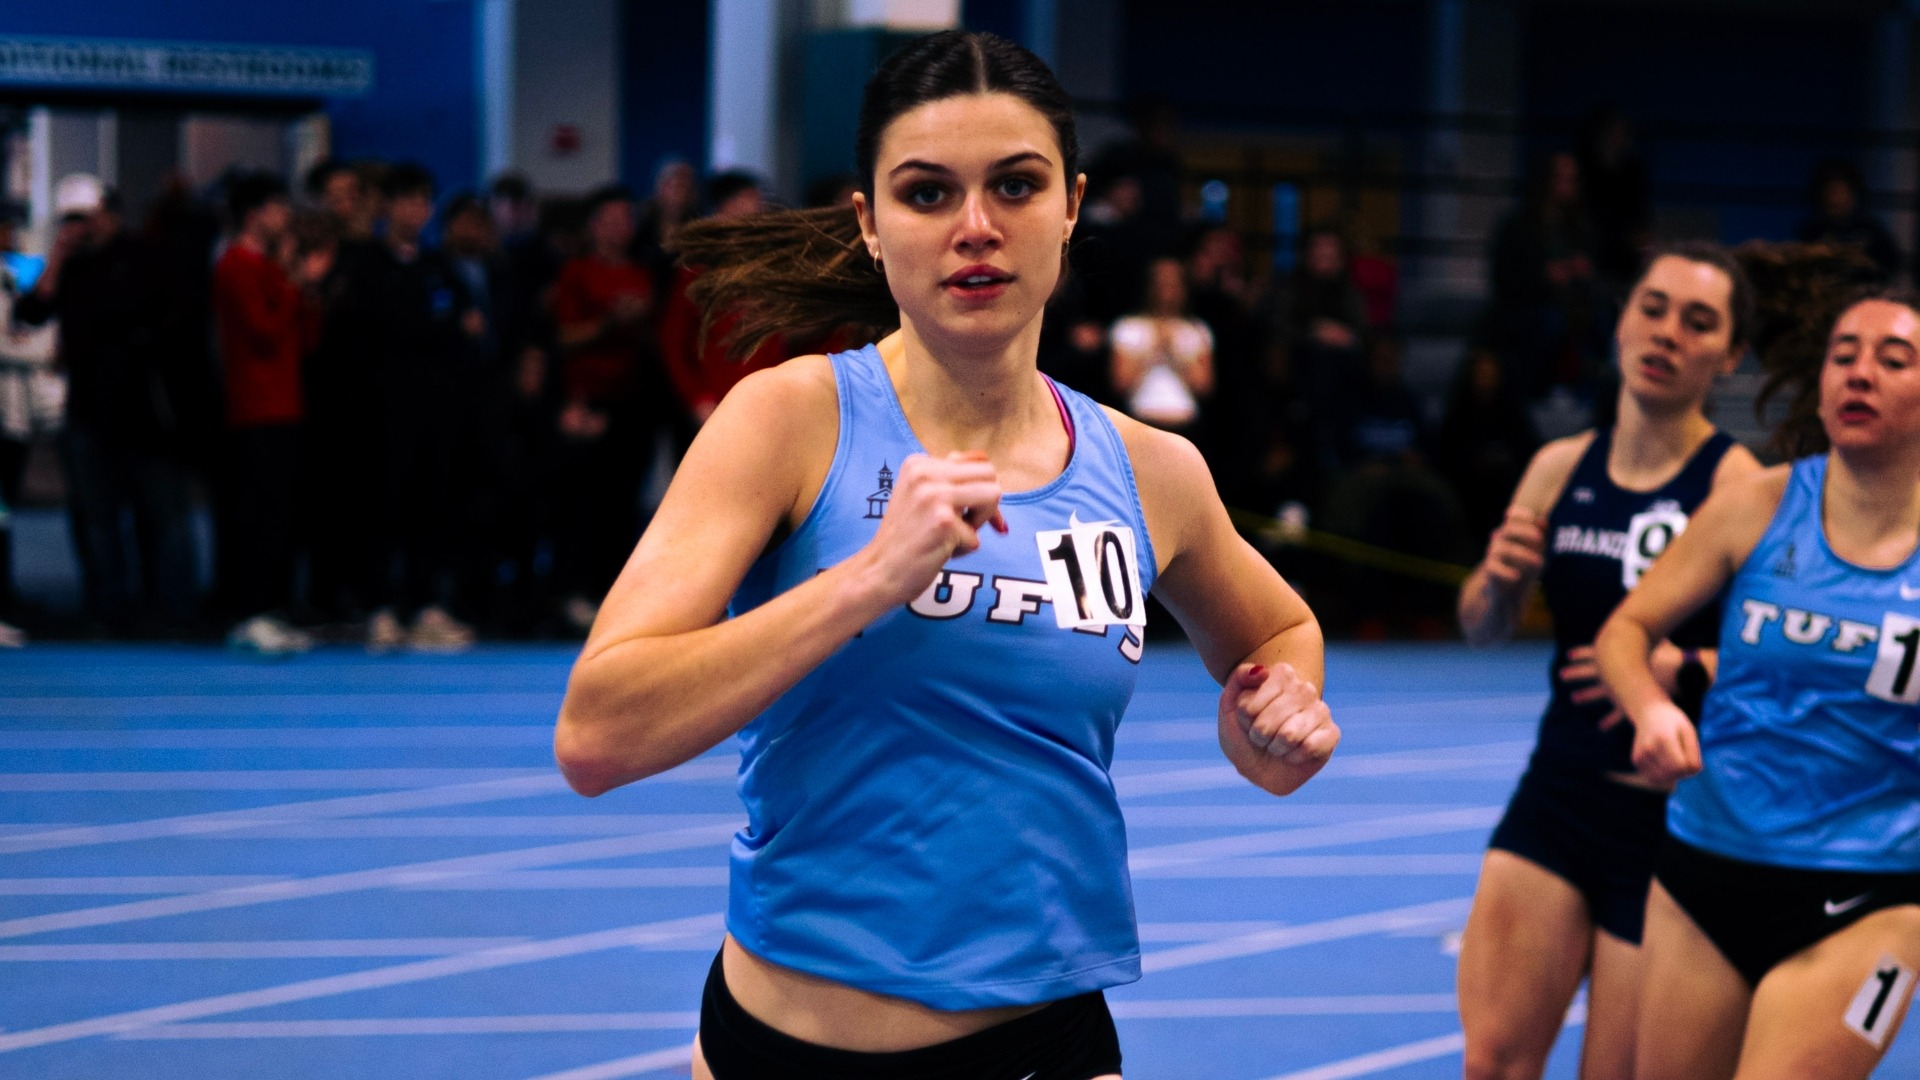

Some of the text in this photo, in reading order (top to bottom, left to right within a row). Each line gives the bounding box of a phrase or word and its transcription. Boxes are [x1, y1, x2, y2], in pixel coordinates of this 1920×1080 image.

[1554, 525, 1628, 558] BRAND
[1048, 530, 1133, 620] 10
[1740, 599, 1878, 652] TUF
[1863, 967, 1899, 1031] 1
